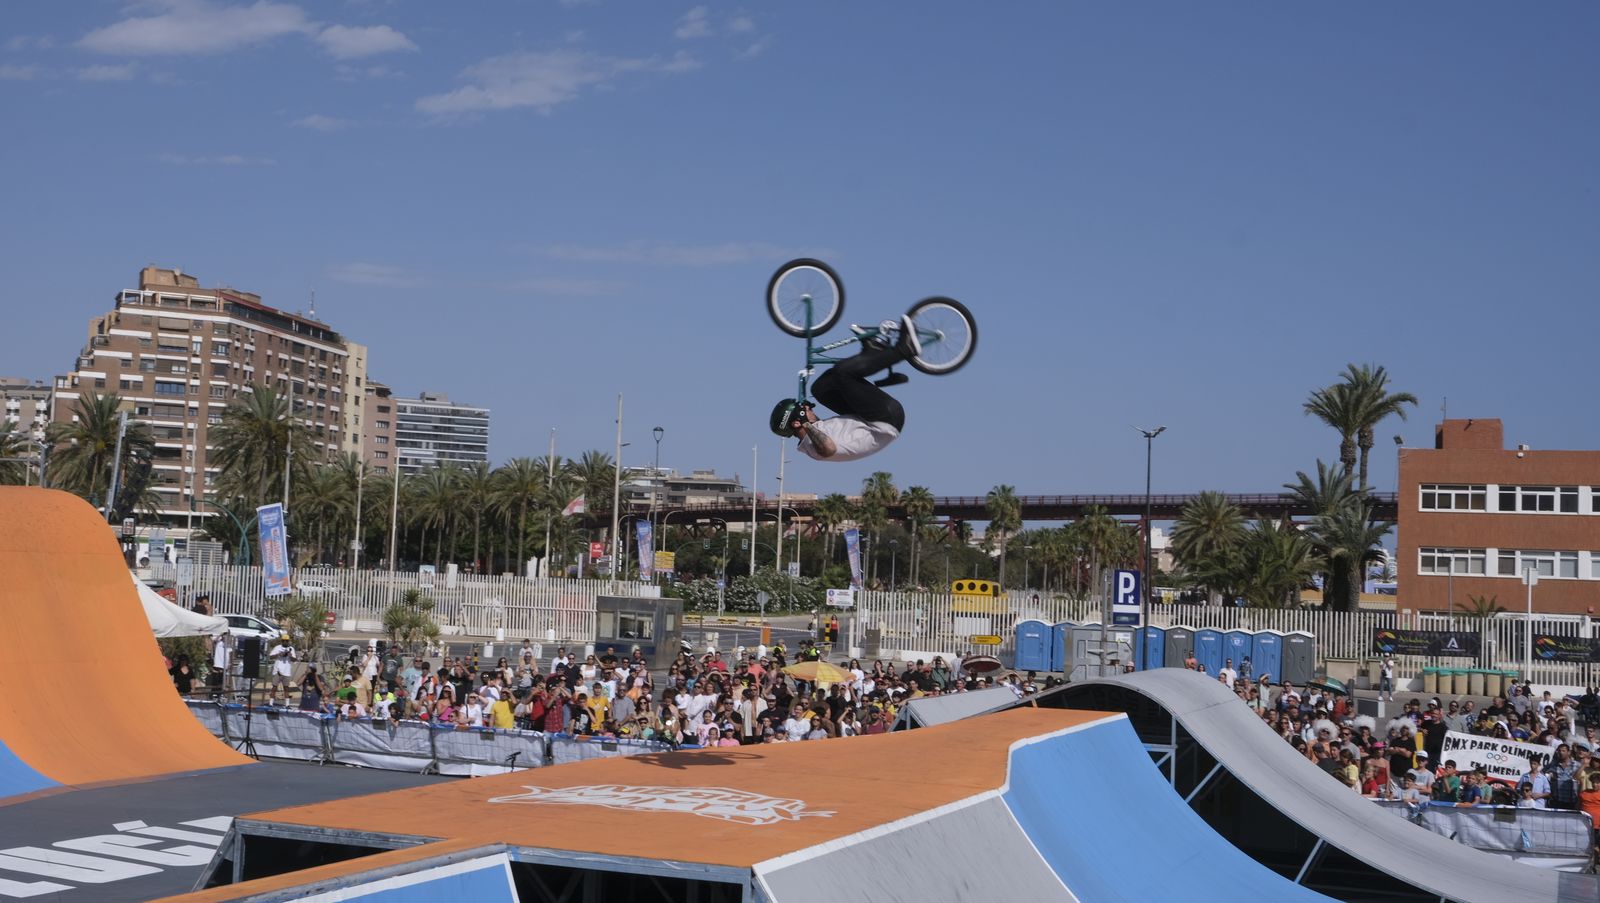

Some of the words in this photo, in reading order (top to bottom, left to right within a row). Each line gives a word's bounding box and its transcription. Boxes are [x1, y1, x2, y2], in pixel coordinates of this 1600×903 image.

[1118, 571, 1136, 604] P
[1443, 736, 1469, 751] BMX
[1470, 739, 1499, 752] PARK
[1500, 744, 1551, 768] OLÍMPO
